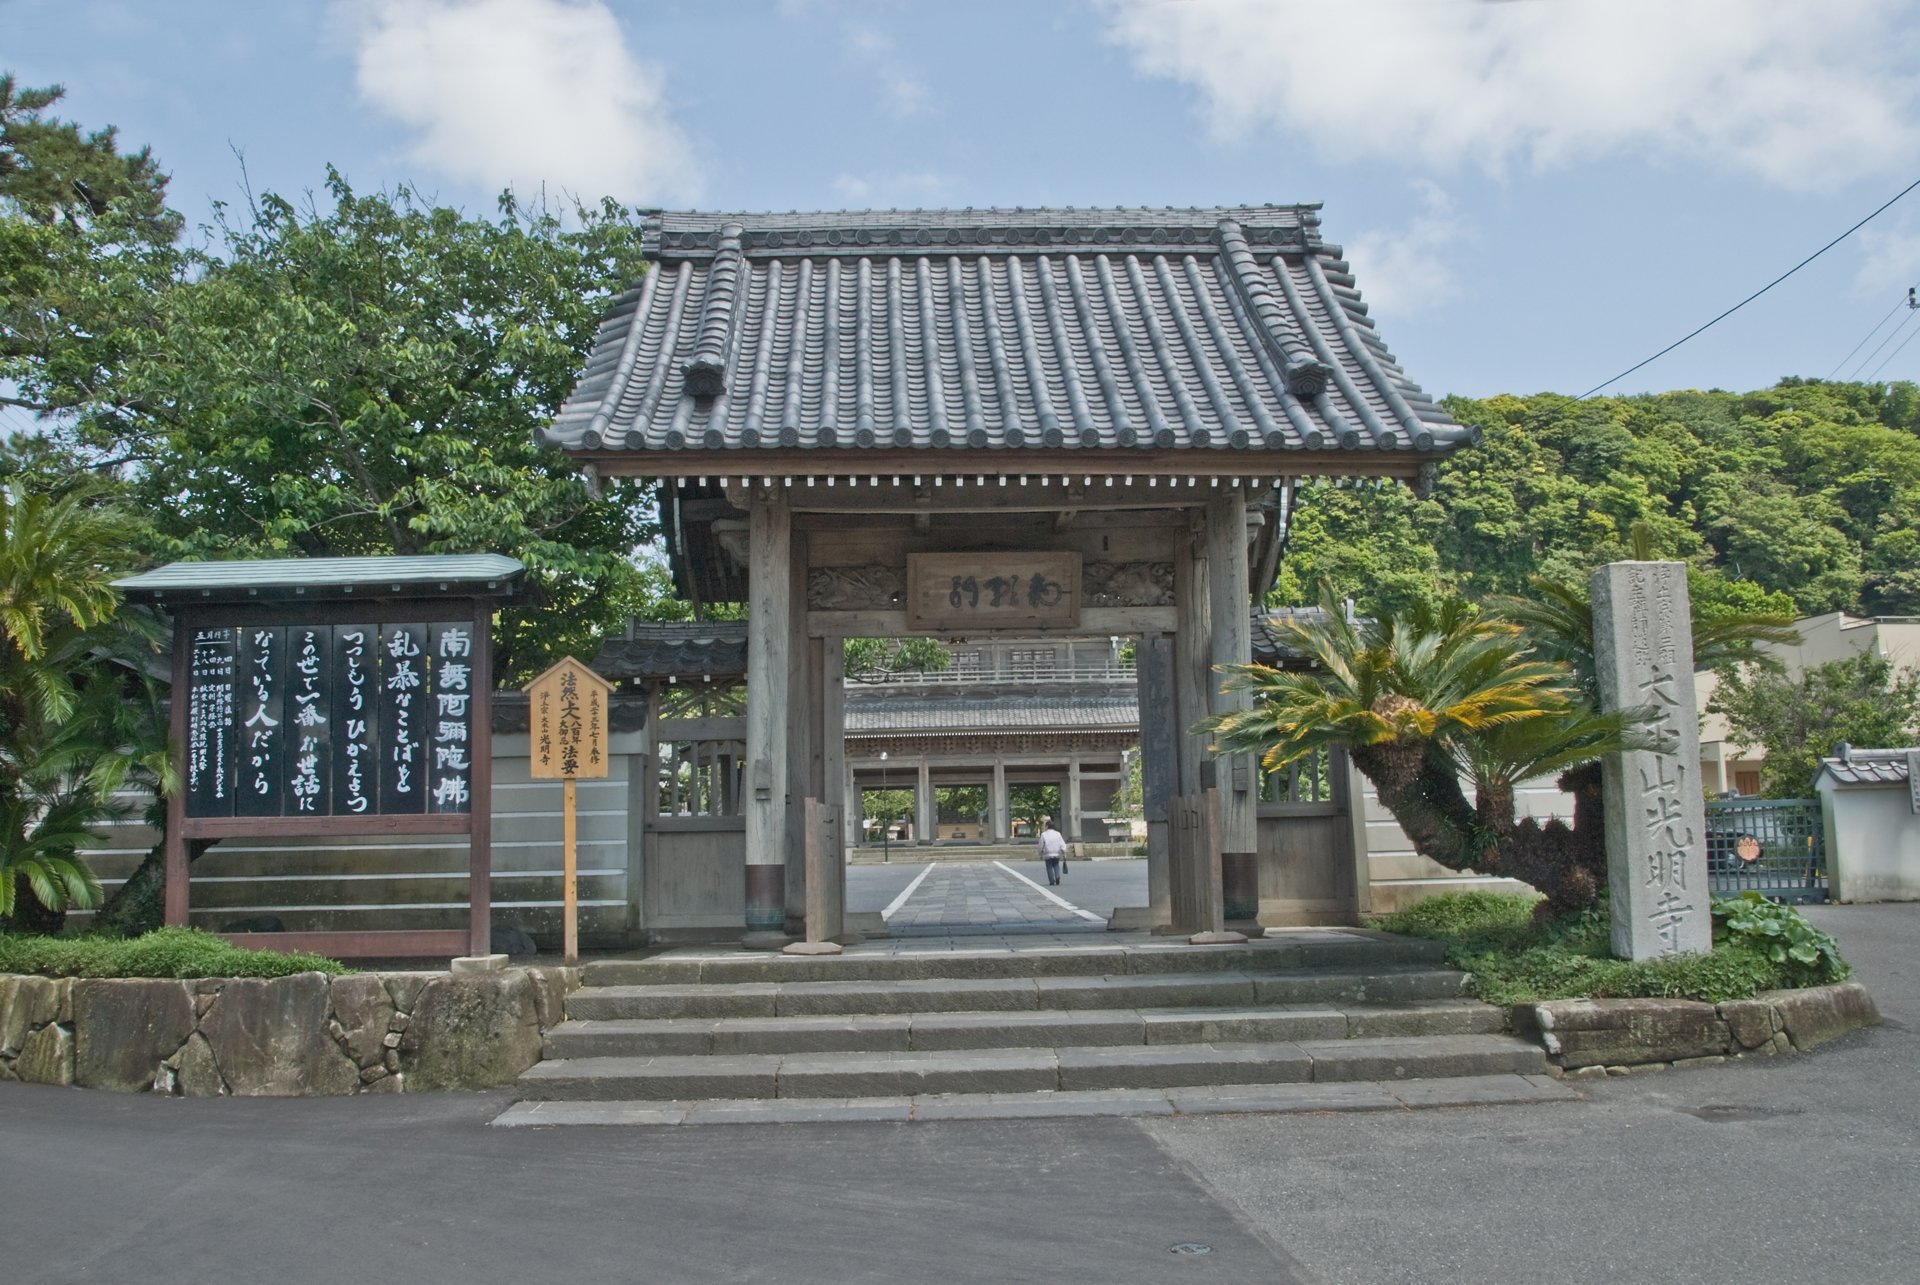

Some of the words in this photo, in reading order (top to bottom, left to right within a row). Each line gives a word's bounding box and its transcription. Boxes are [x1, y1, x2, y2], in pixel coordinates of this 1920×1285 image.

[245, 630, 279, 795] なっている人だから
[295, 631, 326, 727] この世で一番
[343, 631, 365, 711] つつしもう
[387, 630, 420, 793] 乱暴なことばを
[291, 735, 321, 811] お世話に
[346, 719, 368, 812] ひかえよう
